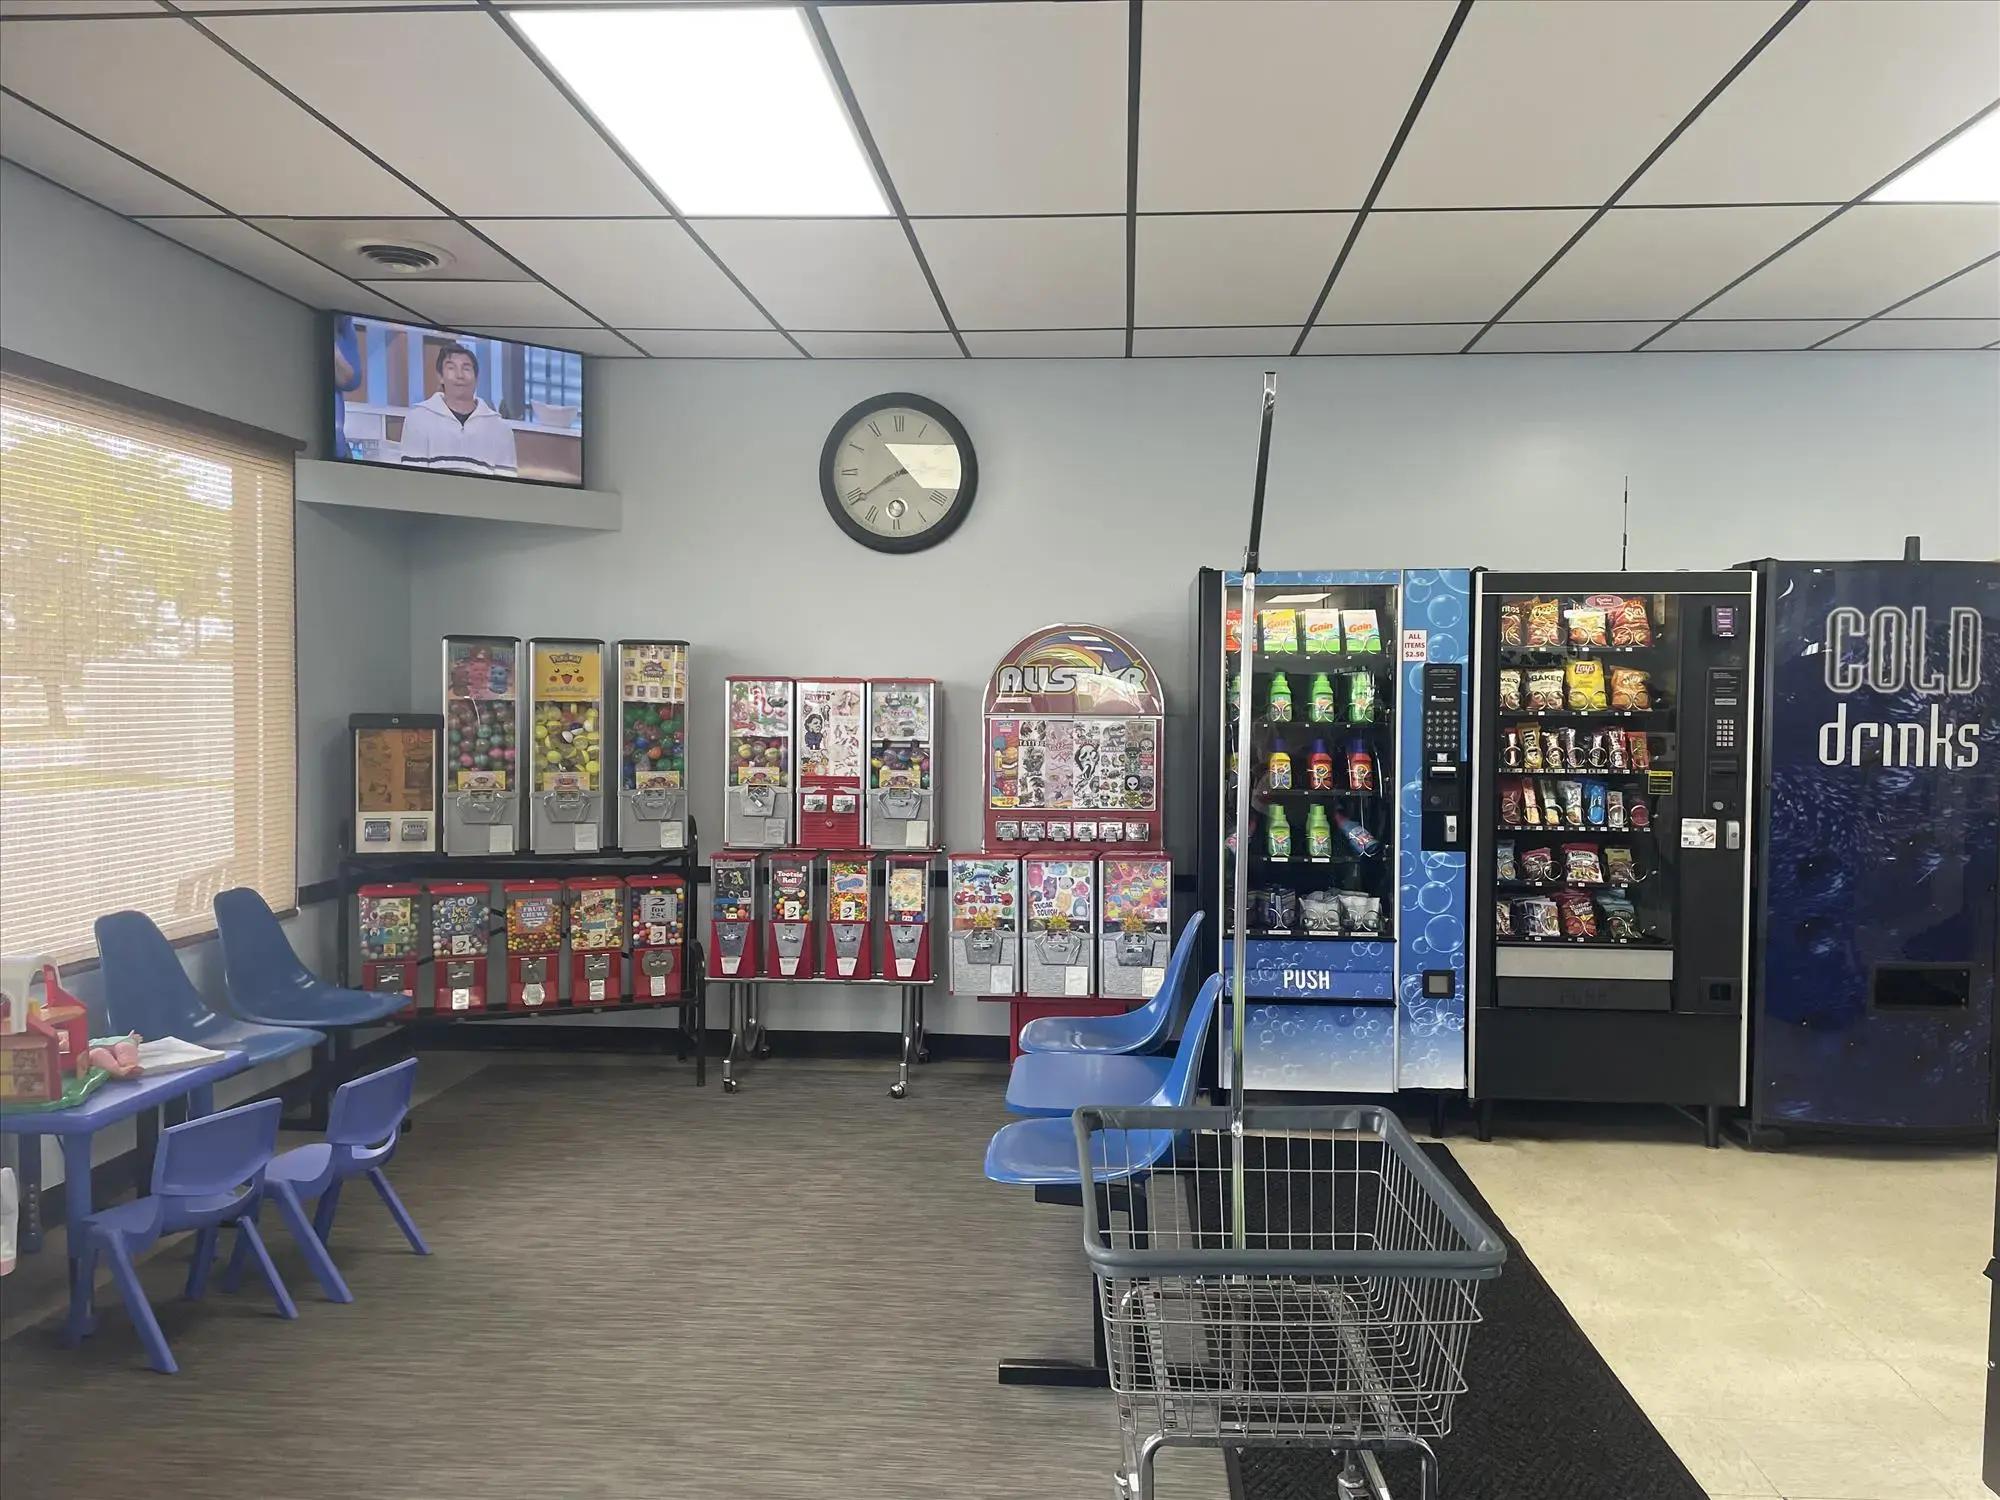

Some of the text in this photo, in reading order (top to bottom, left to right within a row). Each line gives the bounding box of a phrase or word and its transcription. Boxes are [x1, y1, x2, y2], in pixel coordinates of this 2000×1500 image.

[1309, 621, 1333, 633] Gain
[1348, 621, 1373, 633] Gain
[1404, 641, 1426, 649] ITEMS
[1824, 606, 1982, 694] COLD
[1531, 674, 1562, 683] BAKED
[1818, 703, 1981, 771] drinks
[776, 870, 804, 878] Tootsie
[651, 897, 666, 906] 2
[1284, 969, 1330, 989] PUSH
